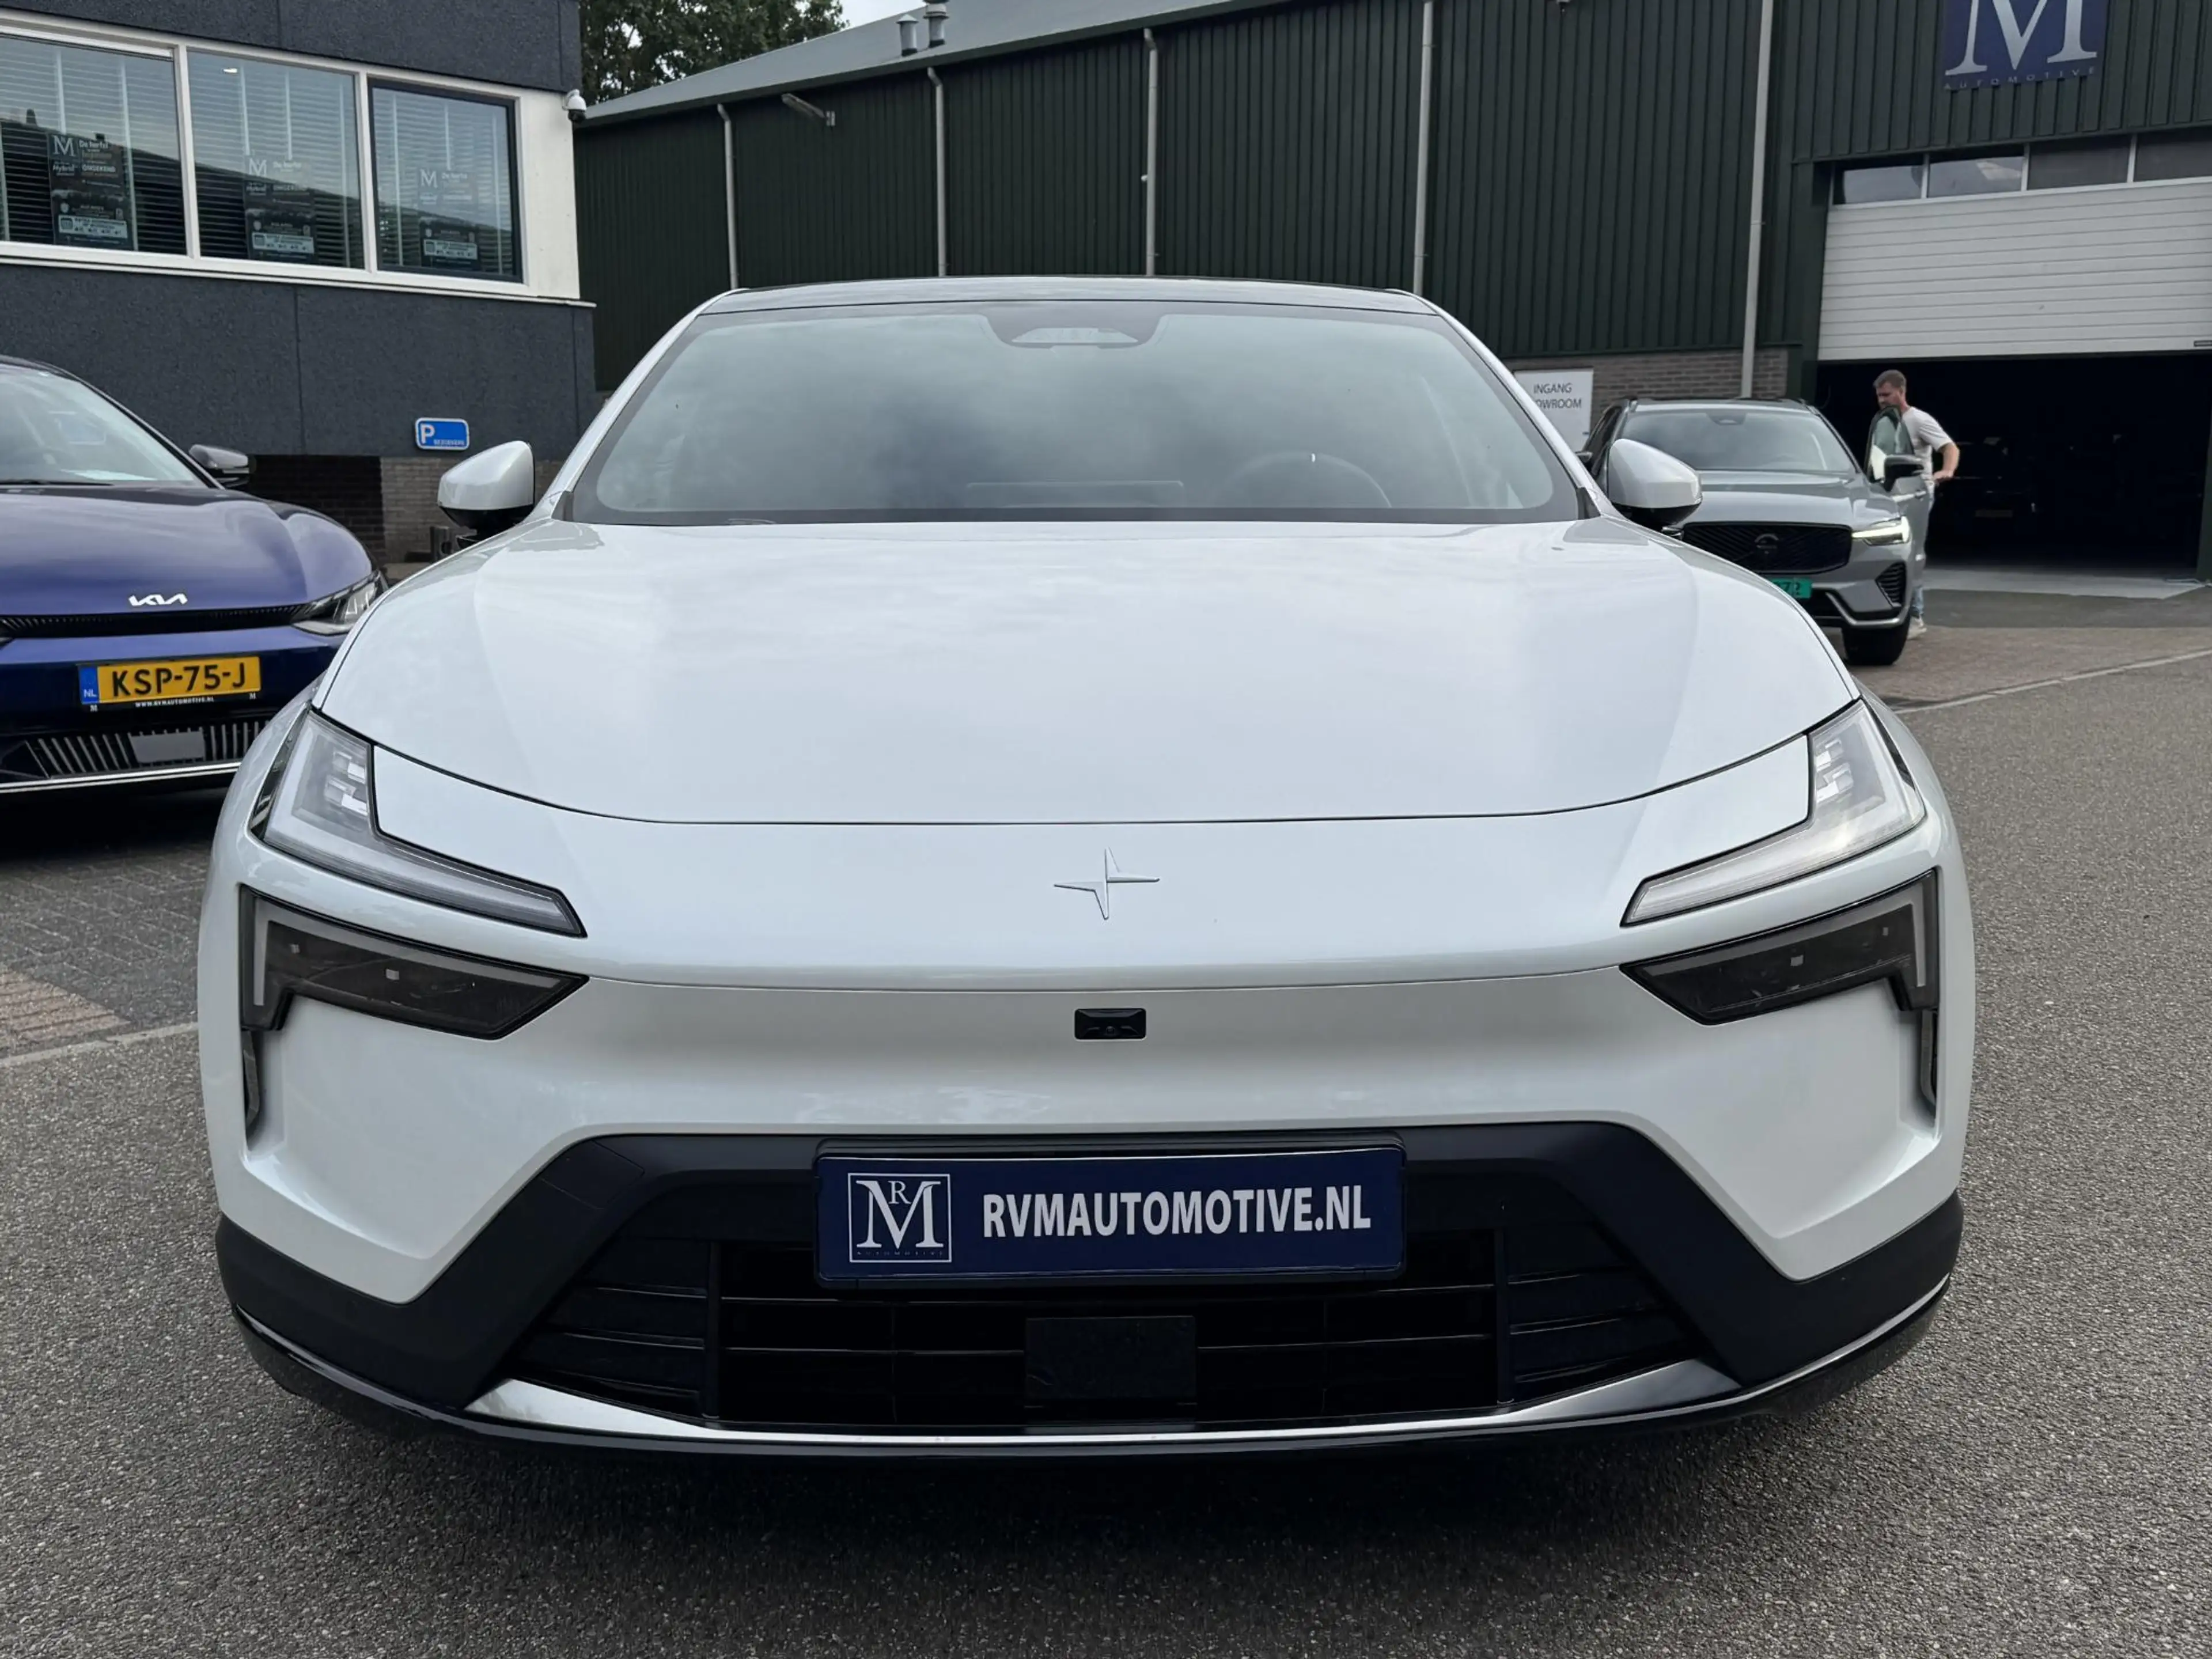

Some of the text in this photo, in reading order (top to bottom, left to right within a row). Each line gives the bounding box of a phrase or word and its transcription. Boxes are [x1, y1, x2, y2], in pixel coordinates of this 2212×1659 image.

[1944, 66, 2095, 90] AUTOMOTIVE
[1533, 382, 1573, 393] INGANG
[1535, 397, 1582, 409] OWROOM
[421, 423, 435, 444] P
[128, 593, 188, 607] KIA
[112, 662, 245, 697] KSP-75-J
[84, 689, 97, 698] NL
[983, 1185, 1371, 1238] RVMAUTOMOTIVE.NL
